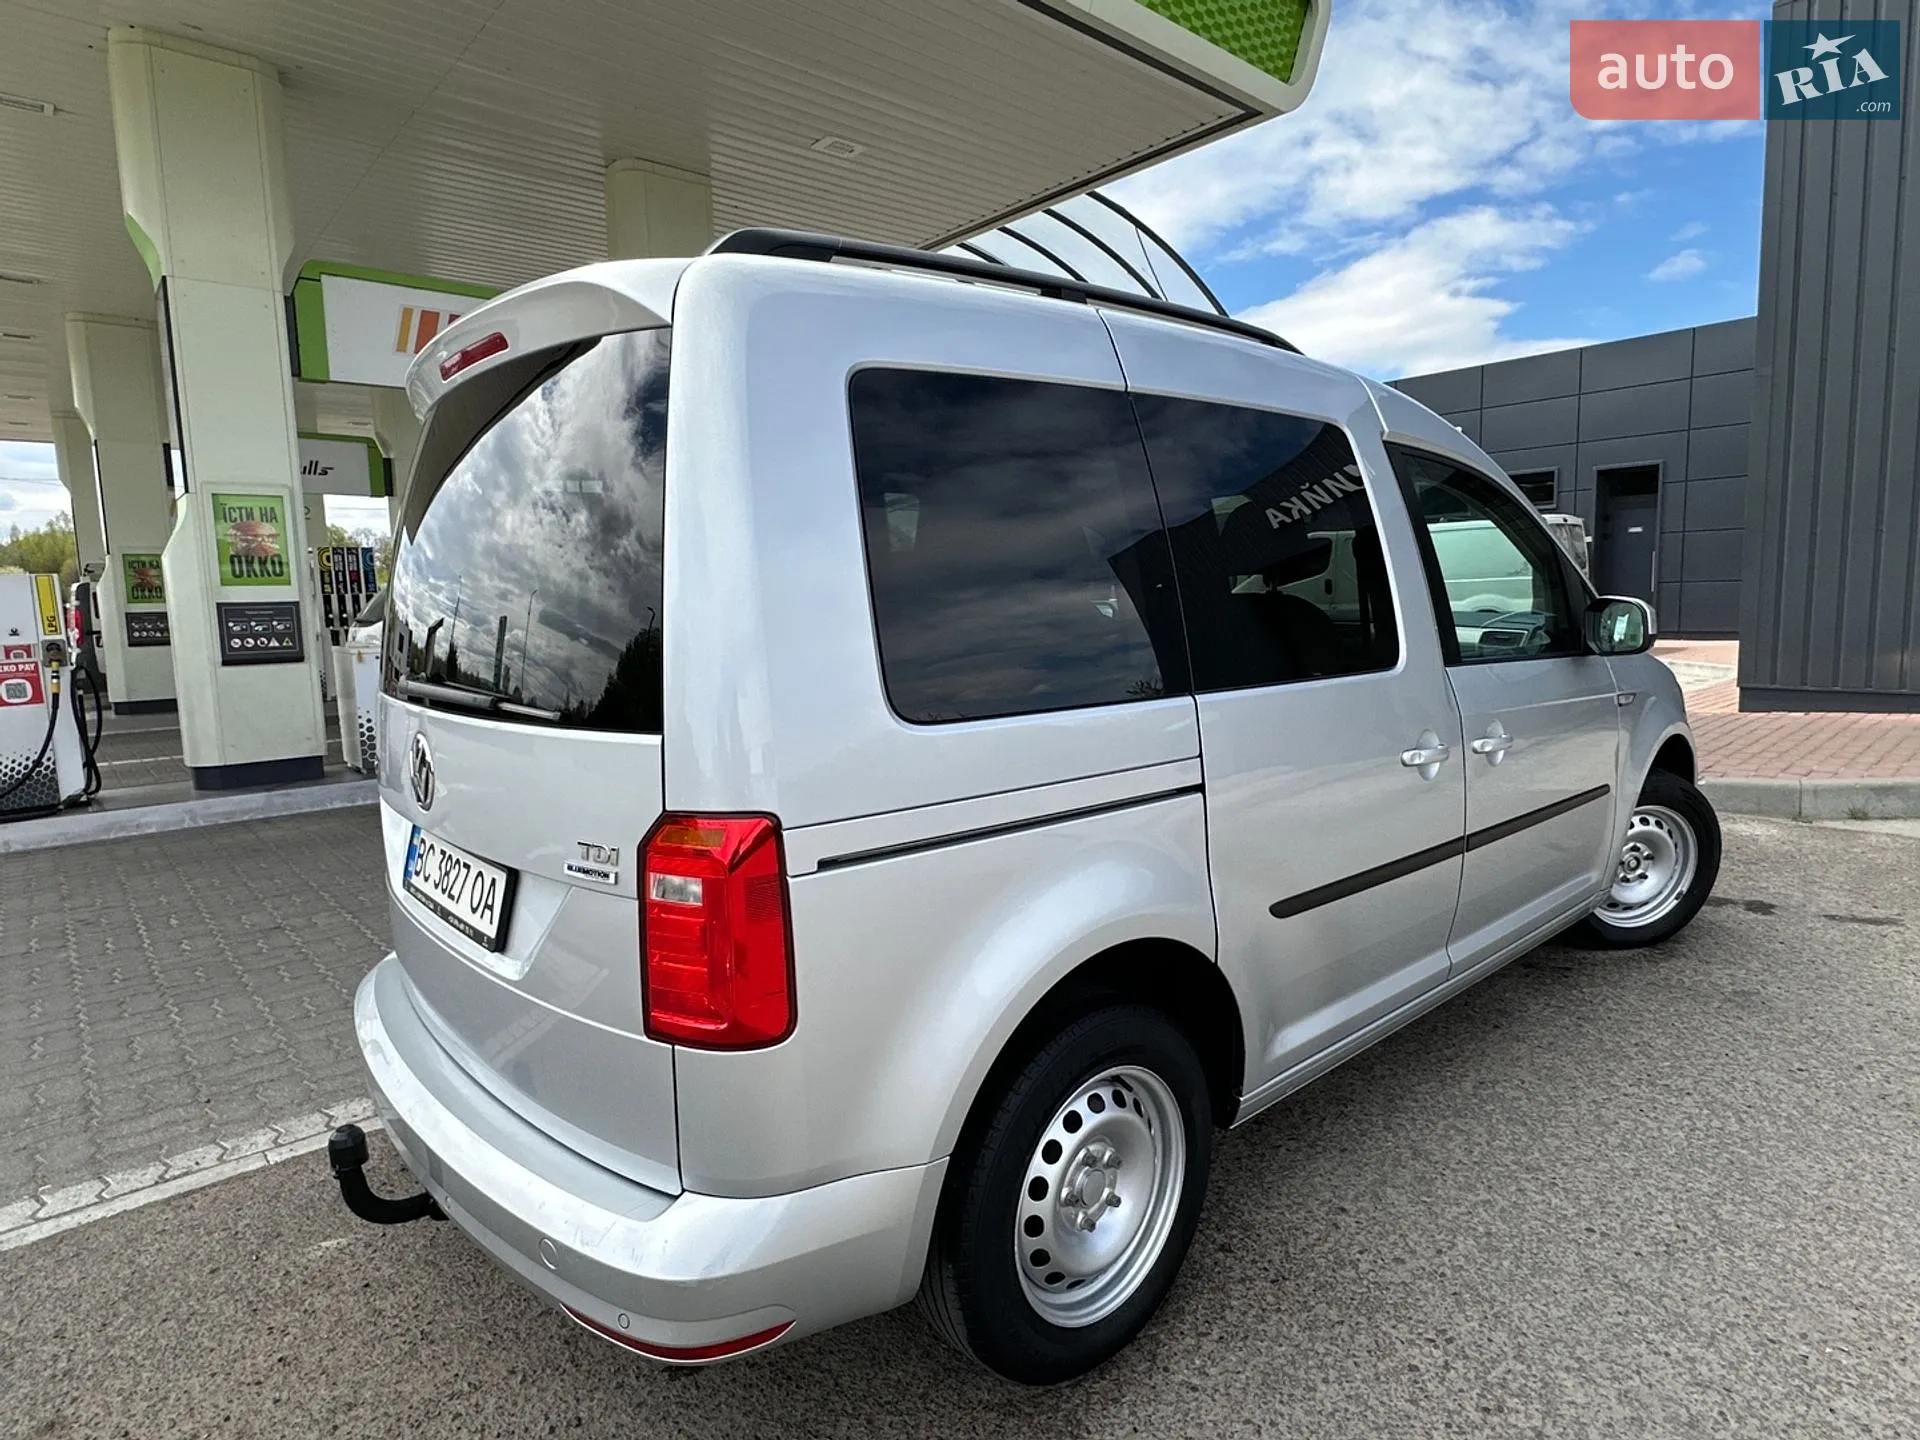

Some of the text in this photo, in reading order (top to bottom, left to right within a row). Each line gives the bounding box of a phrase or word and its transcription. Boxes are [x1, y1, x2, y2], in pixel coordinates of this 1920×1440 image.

[220, 503, 279, 524] ЇСТИ НА
[47, 615, 57, 633] LPG
[18, 662, 36, 672] PAY
[576, 840, 619, 867] TDI
[414, 837, 435, 882] BC
[433, 848, 471, 904] 3827
[470, 870, 497, 925] OA
